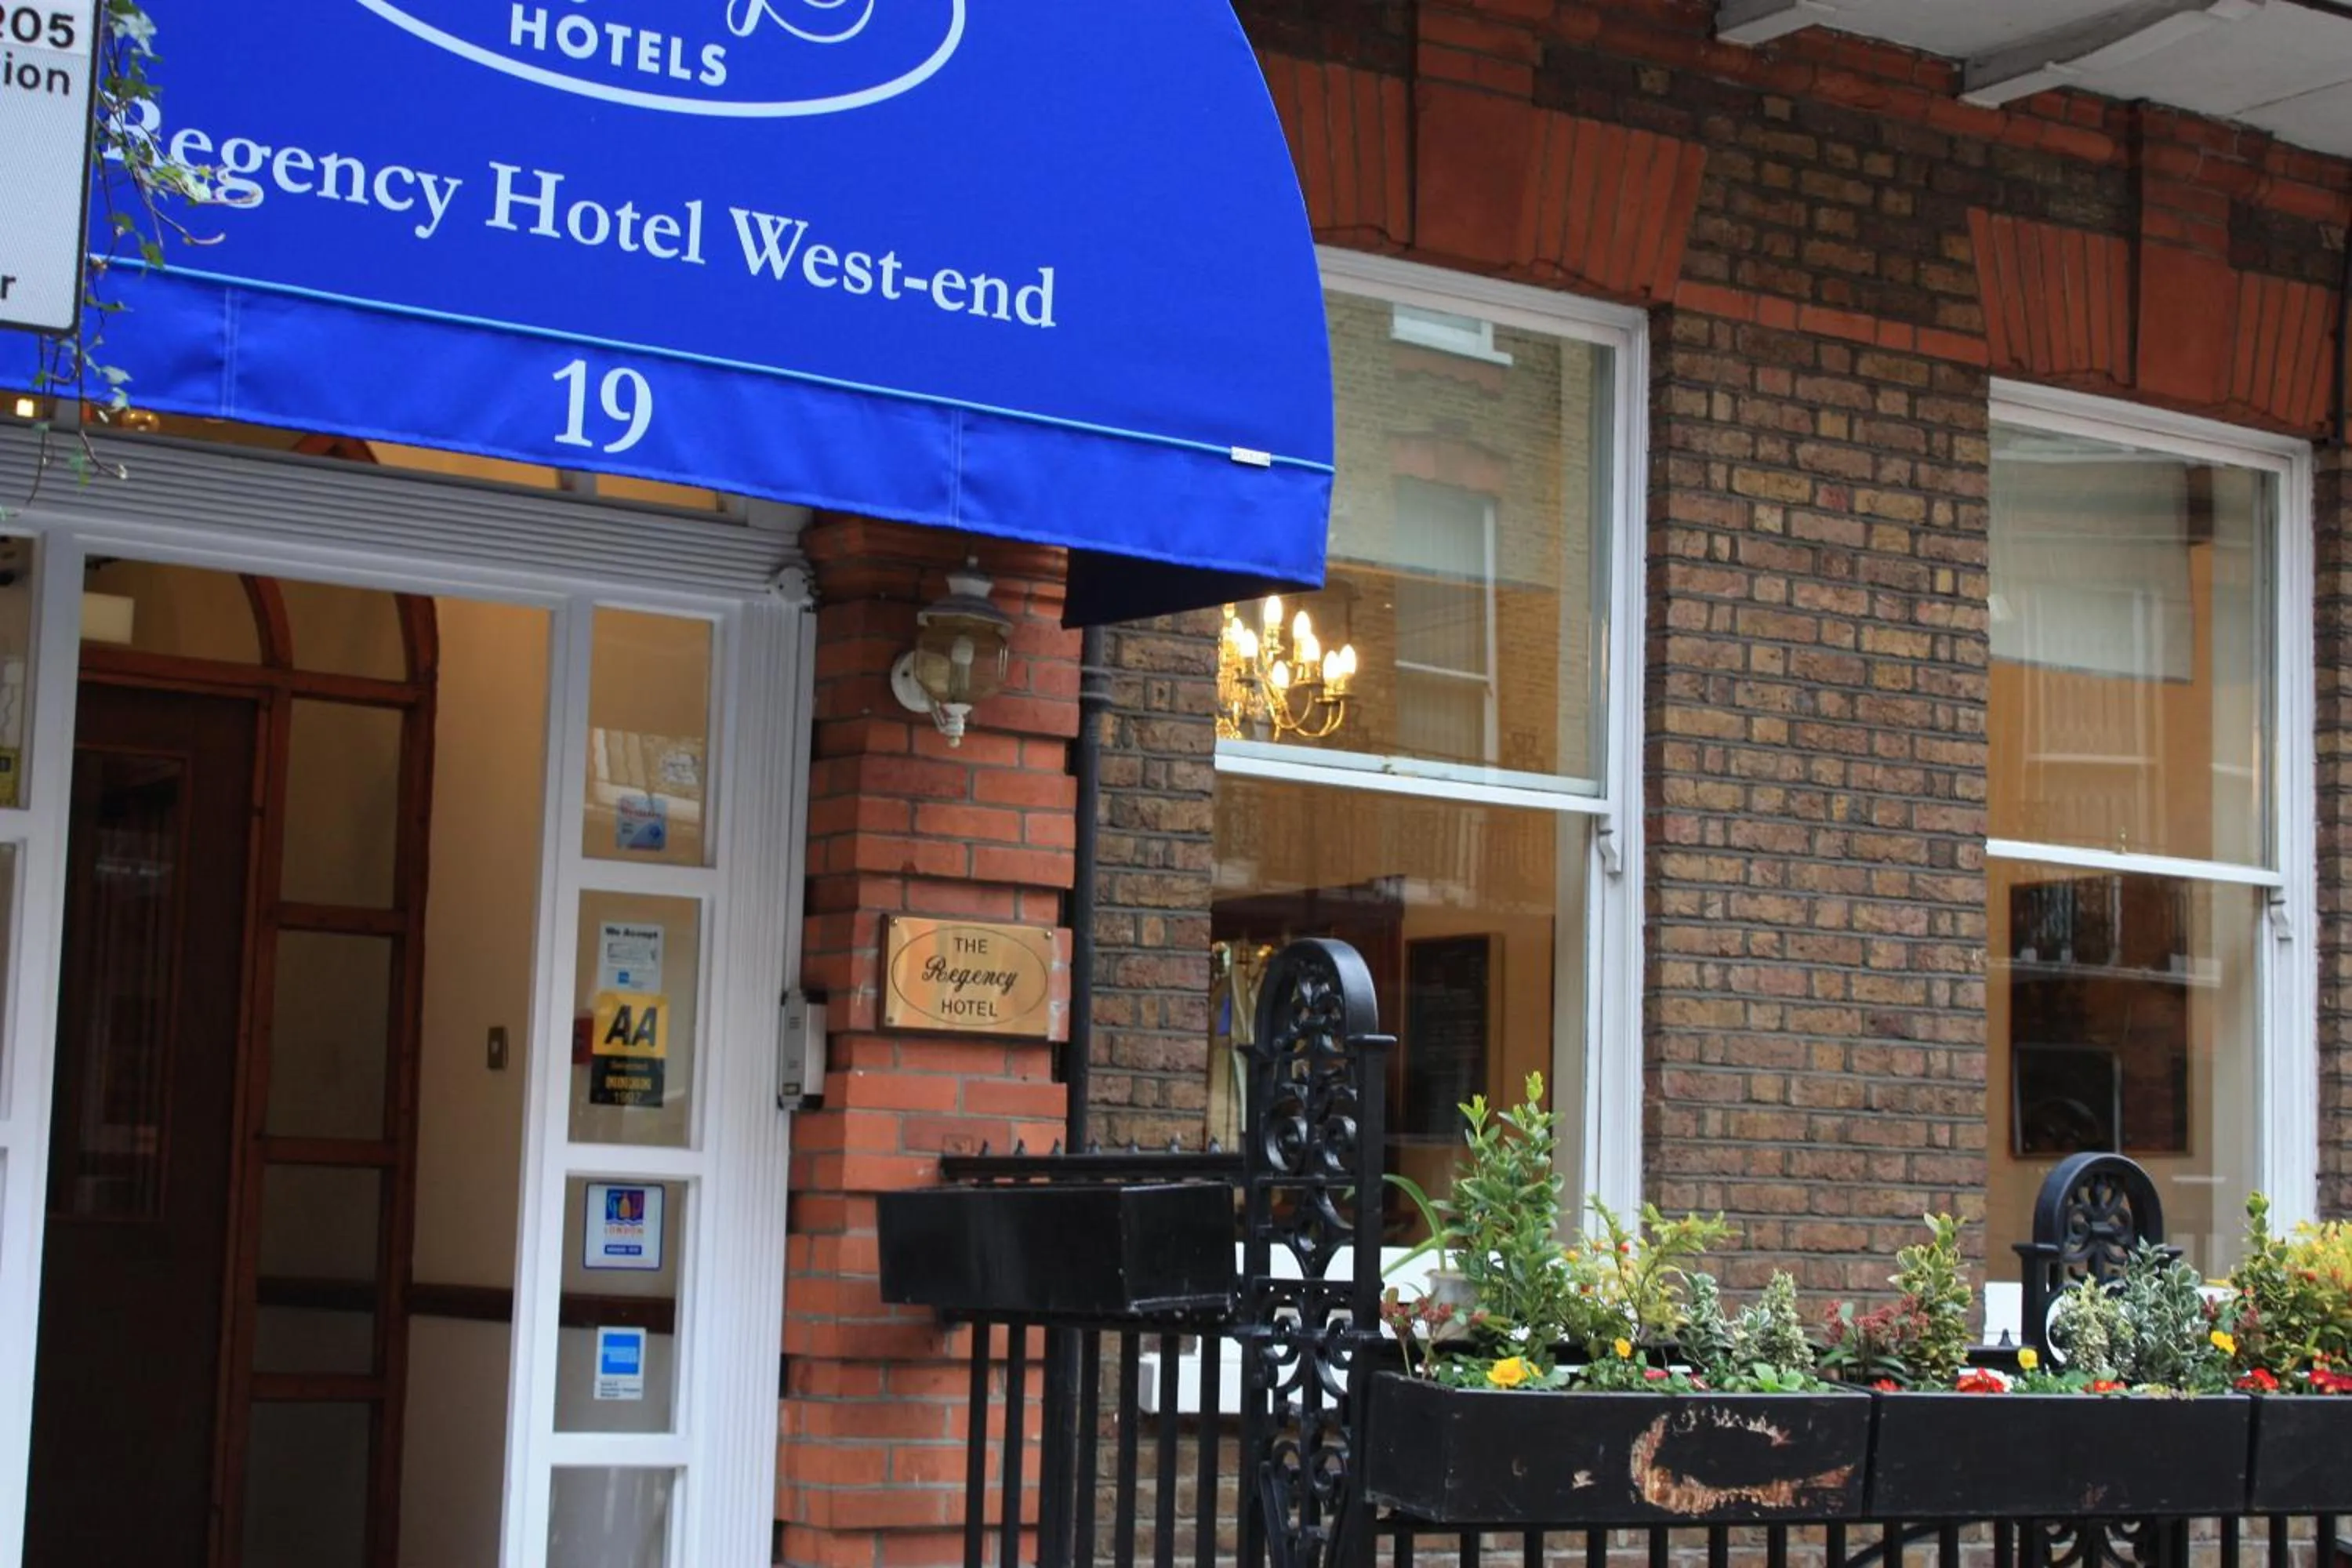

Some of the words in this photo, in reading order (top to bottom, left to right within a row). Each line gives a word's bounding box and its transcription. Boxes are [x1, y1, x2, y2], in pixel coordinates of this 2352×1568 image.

[510, 3, 727, 87] HOTELS
[102, 90, 463, 239] Regency
[485, 161, 706, 265] Hotel
[728, 206, 1057, 328] West-end
[552, 358, 653, 454] 19
[953, 937, 989, 954] THE
[921, 955, 1018, 995] Regency
[604, 1004, 658, 1047] AA
[941, 1000, 998, 1018] HOTEL
